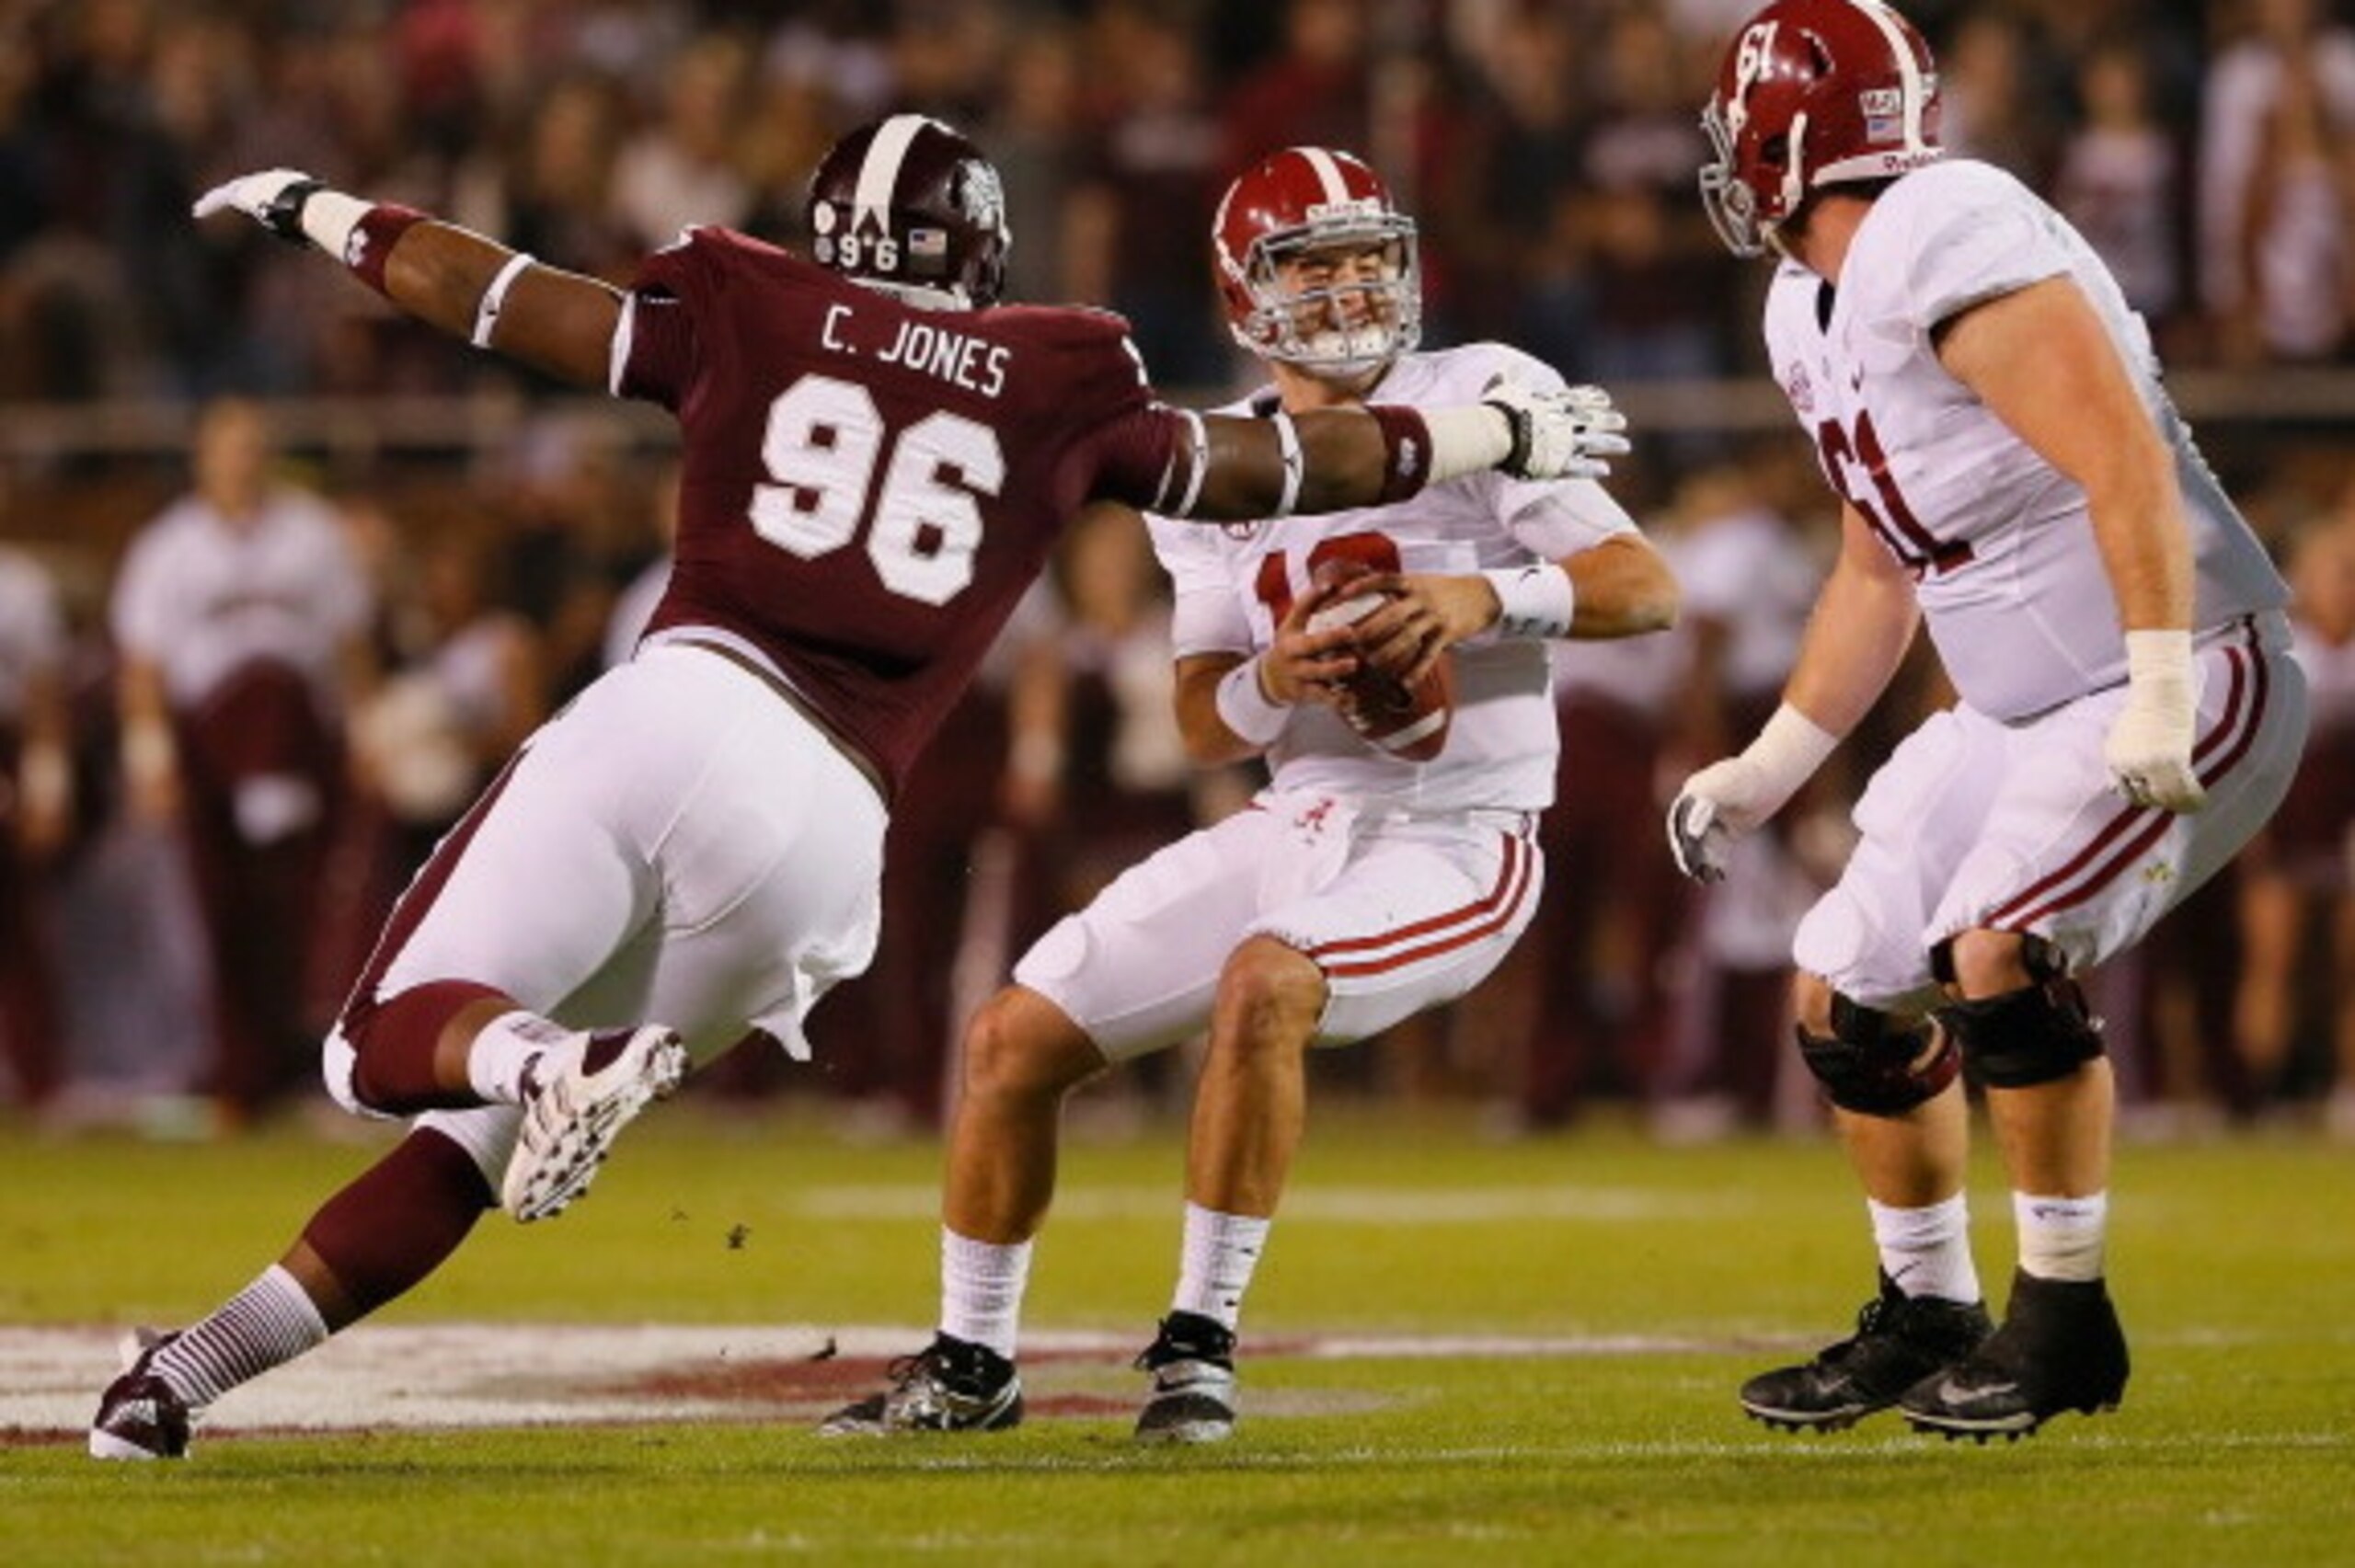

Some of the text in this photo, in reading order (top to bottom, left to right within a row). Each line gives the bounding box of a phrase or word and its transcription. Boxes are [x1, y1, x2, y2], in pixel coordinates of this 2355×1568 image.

[839, 233, 898, 271] 96
[821, 304, 1011, 398] C. JONES
[748, 372, 1007, 607] 96
[1817, 408, 1976, 583] 61
